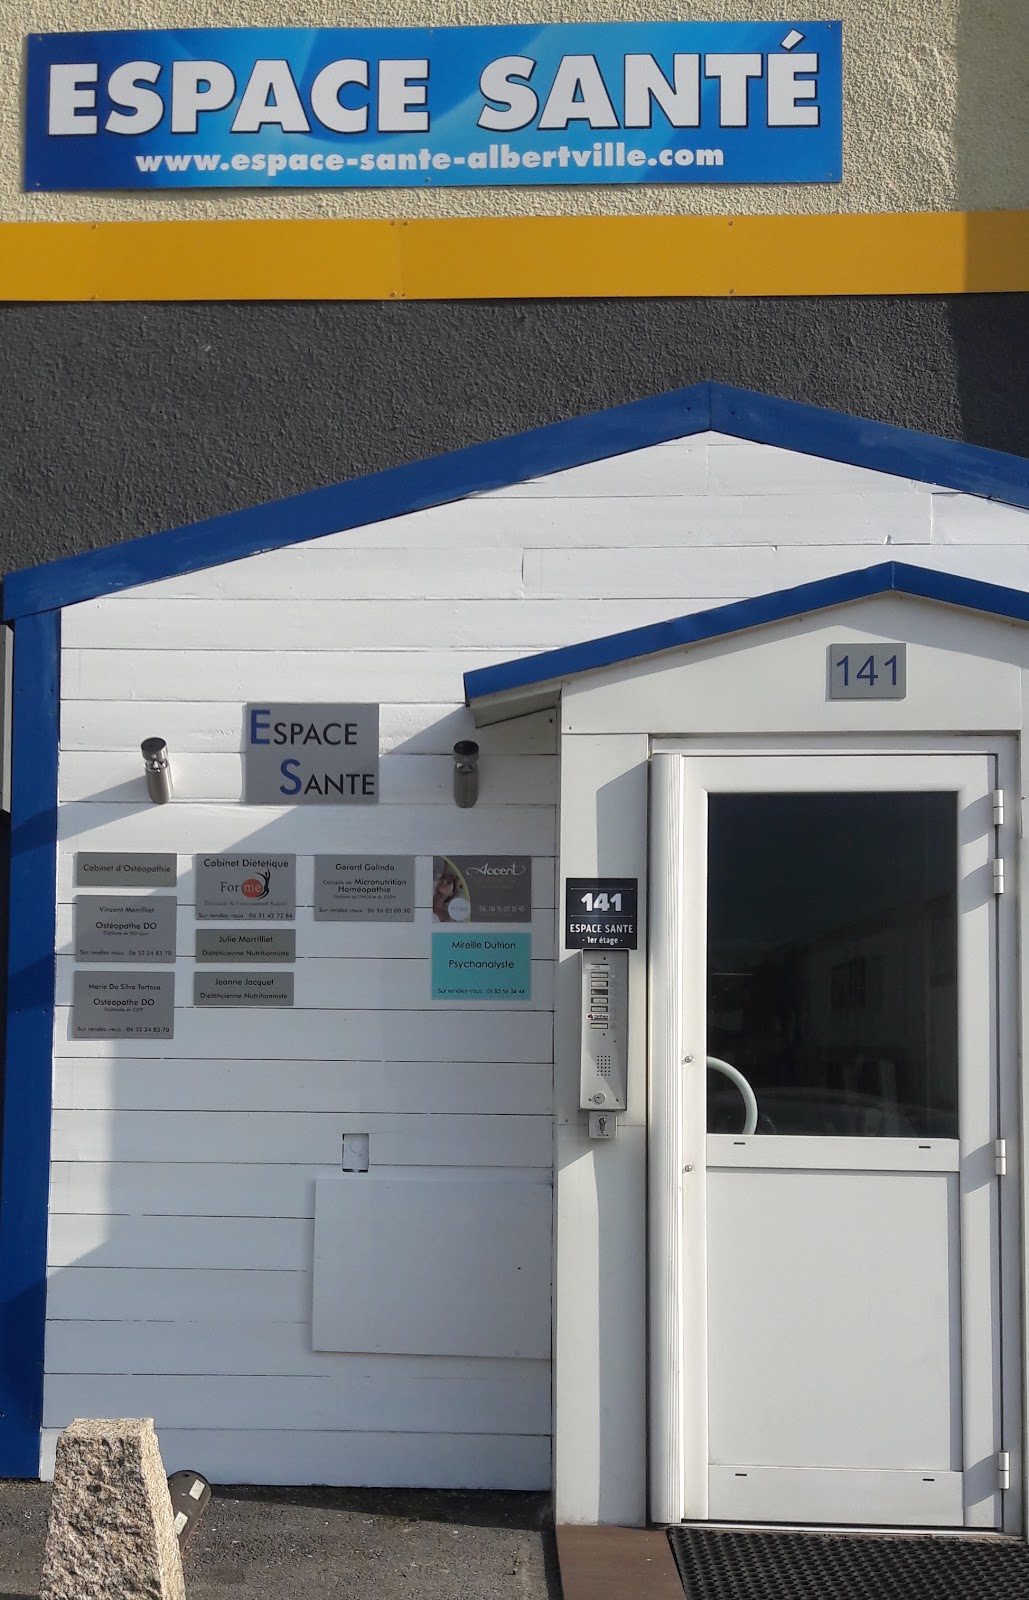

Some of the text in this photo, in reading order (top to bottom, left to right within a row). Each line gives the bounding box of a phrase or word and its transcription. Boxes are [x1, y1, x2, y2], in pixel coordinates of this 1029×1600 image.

[48, 28, 820, 136] ESPACE SANTÉ
[135, 142, 724, 176] www.espace-sante-albertville.com
[836, 655, 897, 686] 141
[250, 709, 358, 745] ESPACE
[279, 758, 375, 795] SANTE
[83, 864, 114, 872] Cabinet
[204, 859, 239, 867] Cabinet
[220, 882, 261, 892] For me
[581, 893, 621, 911] 141
[570, 924, 633, 933] ESPACE SANTE
[452, 941, 516, 949] Mireille Dutrion
[599, 936, 618, 945] étage
[449, 960, 514, 970] Psychanalyste
[245, 979, 274, 987] Jacquet
